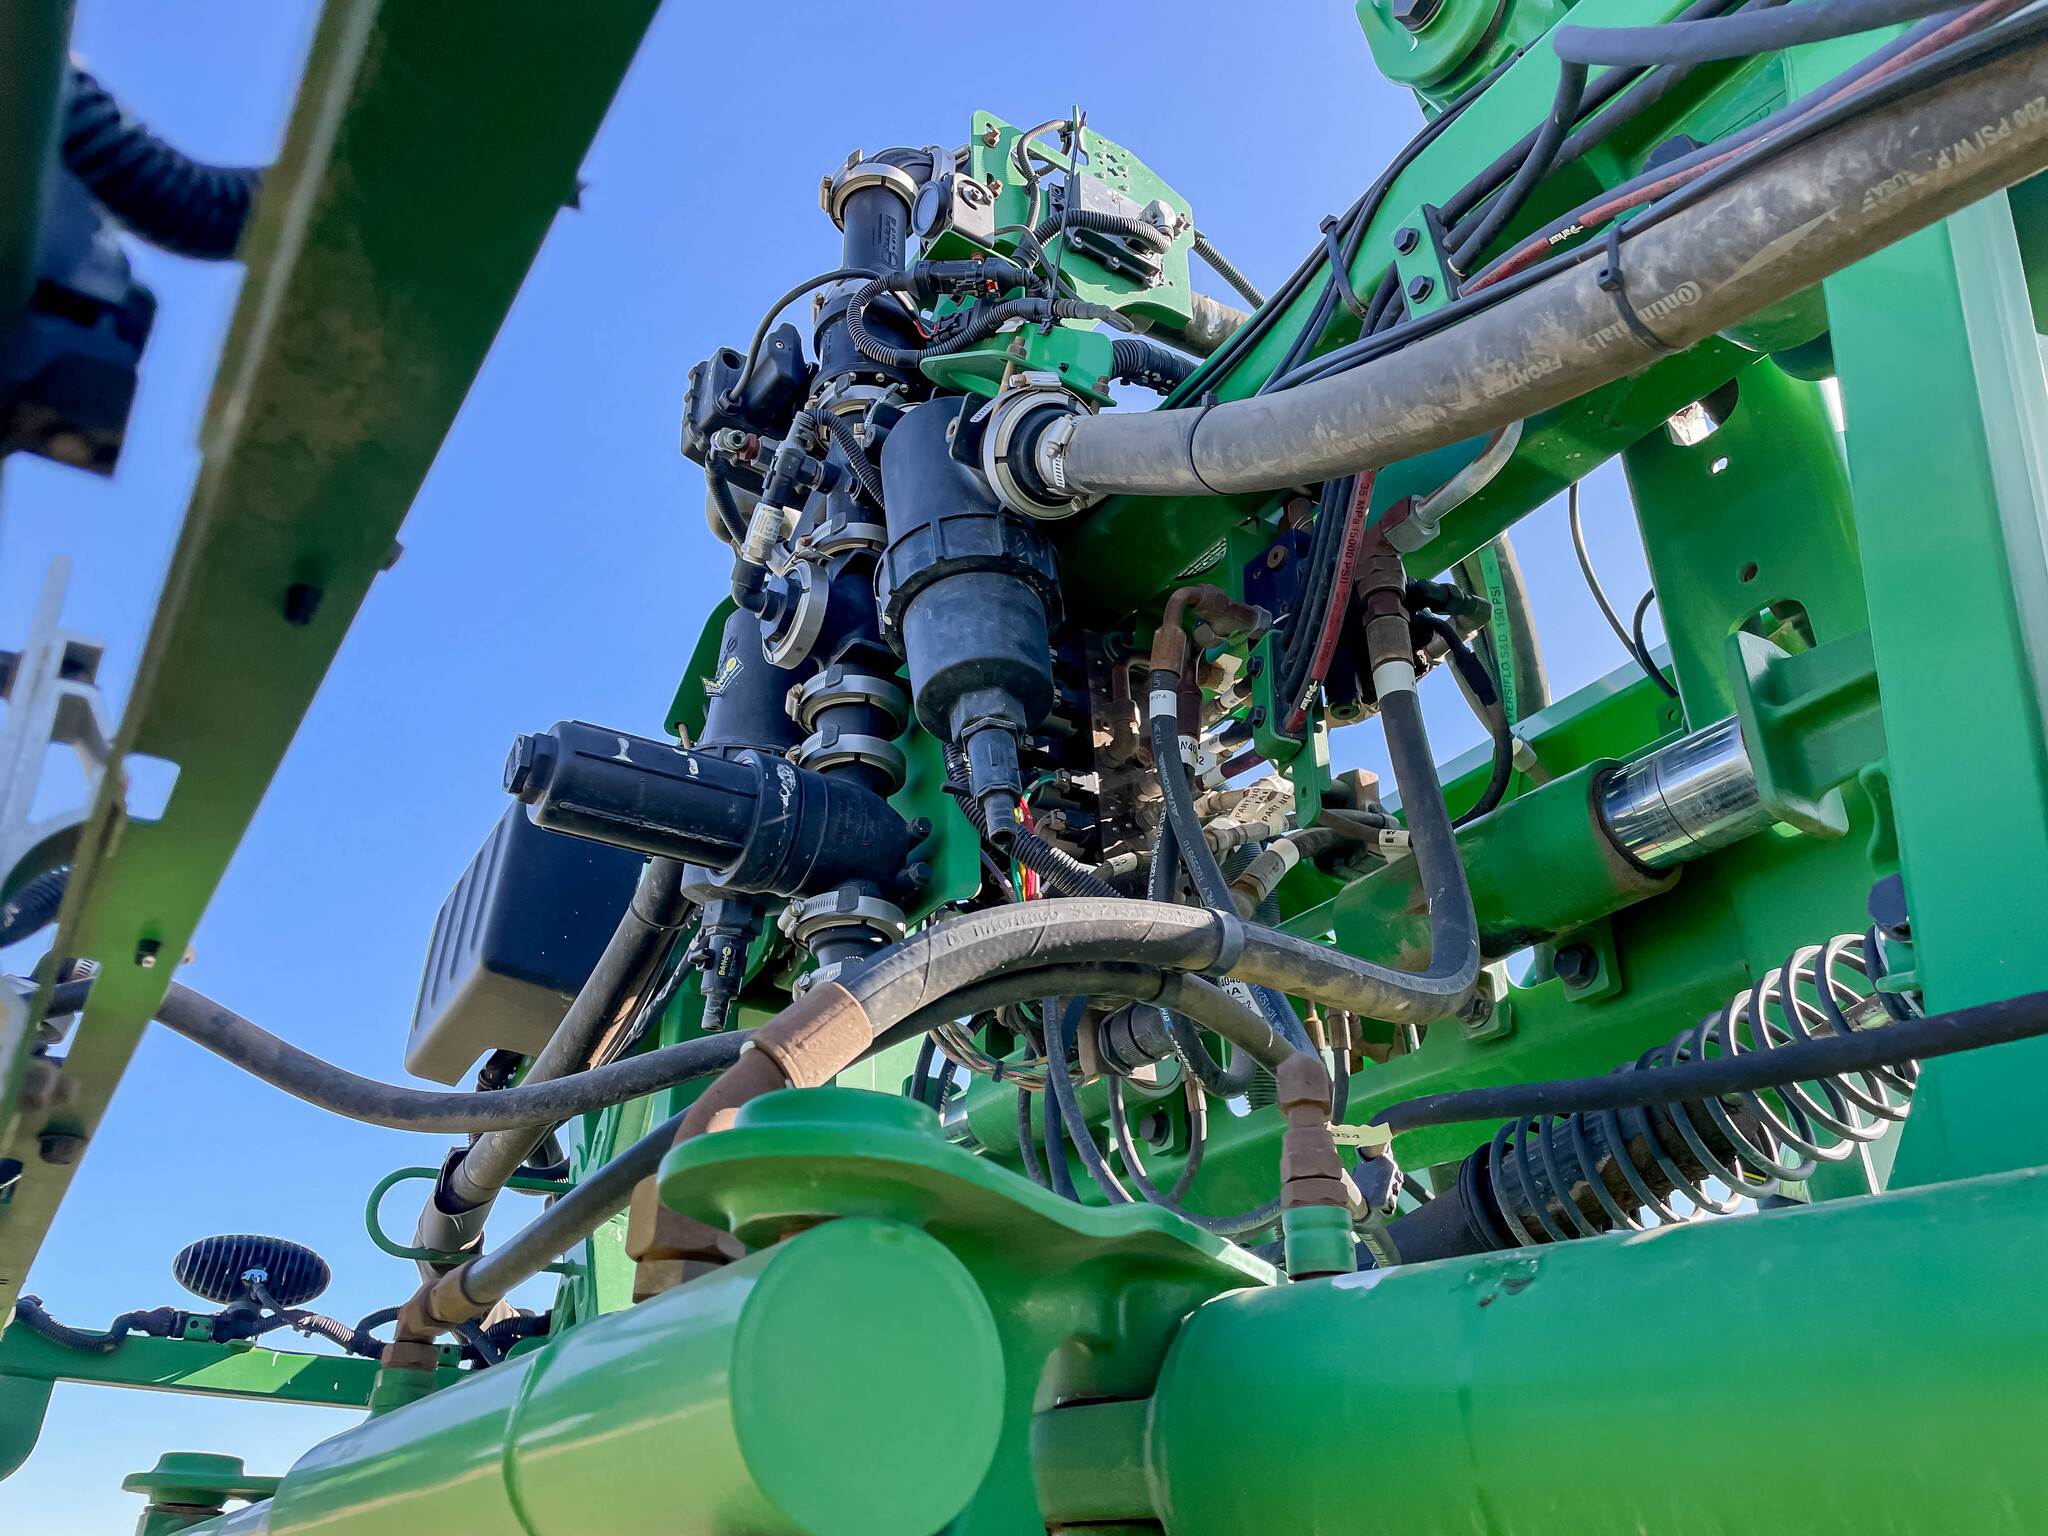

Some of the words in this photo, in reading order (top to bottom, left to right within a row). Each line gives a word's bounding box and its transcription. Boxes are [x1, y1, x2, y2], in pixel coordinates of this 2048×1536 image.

[1973, 117, 2012, 149] PSI
[1549, 224, 1584, 245] Parker
[1593, 280, 1703, 349] Contintal
[1358, 482, 1370, 497] 35
[1352, 500, 1365, 525] MPa
[1345, 528, 1361, 559] (5000
[1339, 561, 1352, 584] PSI)
[1490, 586, 1502, 606] PSI
[1494, 608, 1505, 627] 150
[1299, 680, 1318, 711] Parker
[1502, 661, 1514, 720] VERSIFLO
[1157, 751, 1182, 821] ALFAGOMMA
[1234, 799, 1252, 819] PART
[1261, 804, 1281, 823] PART
